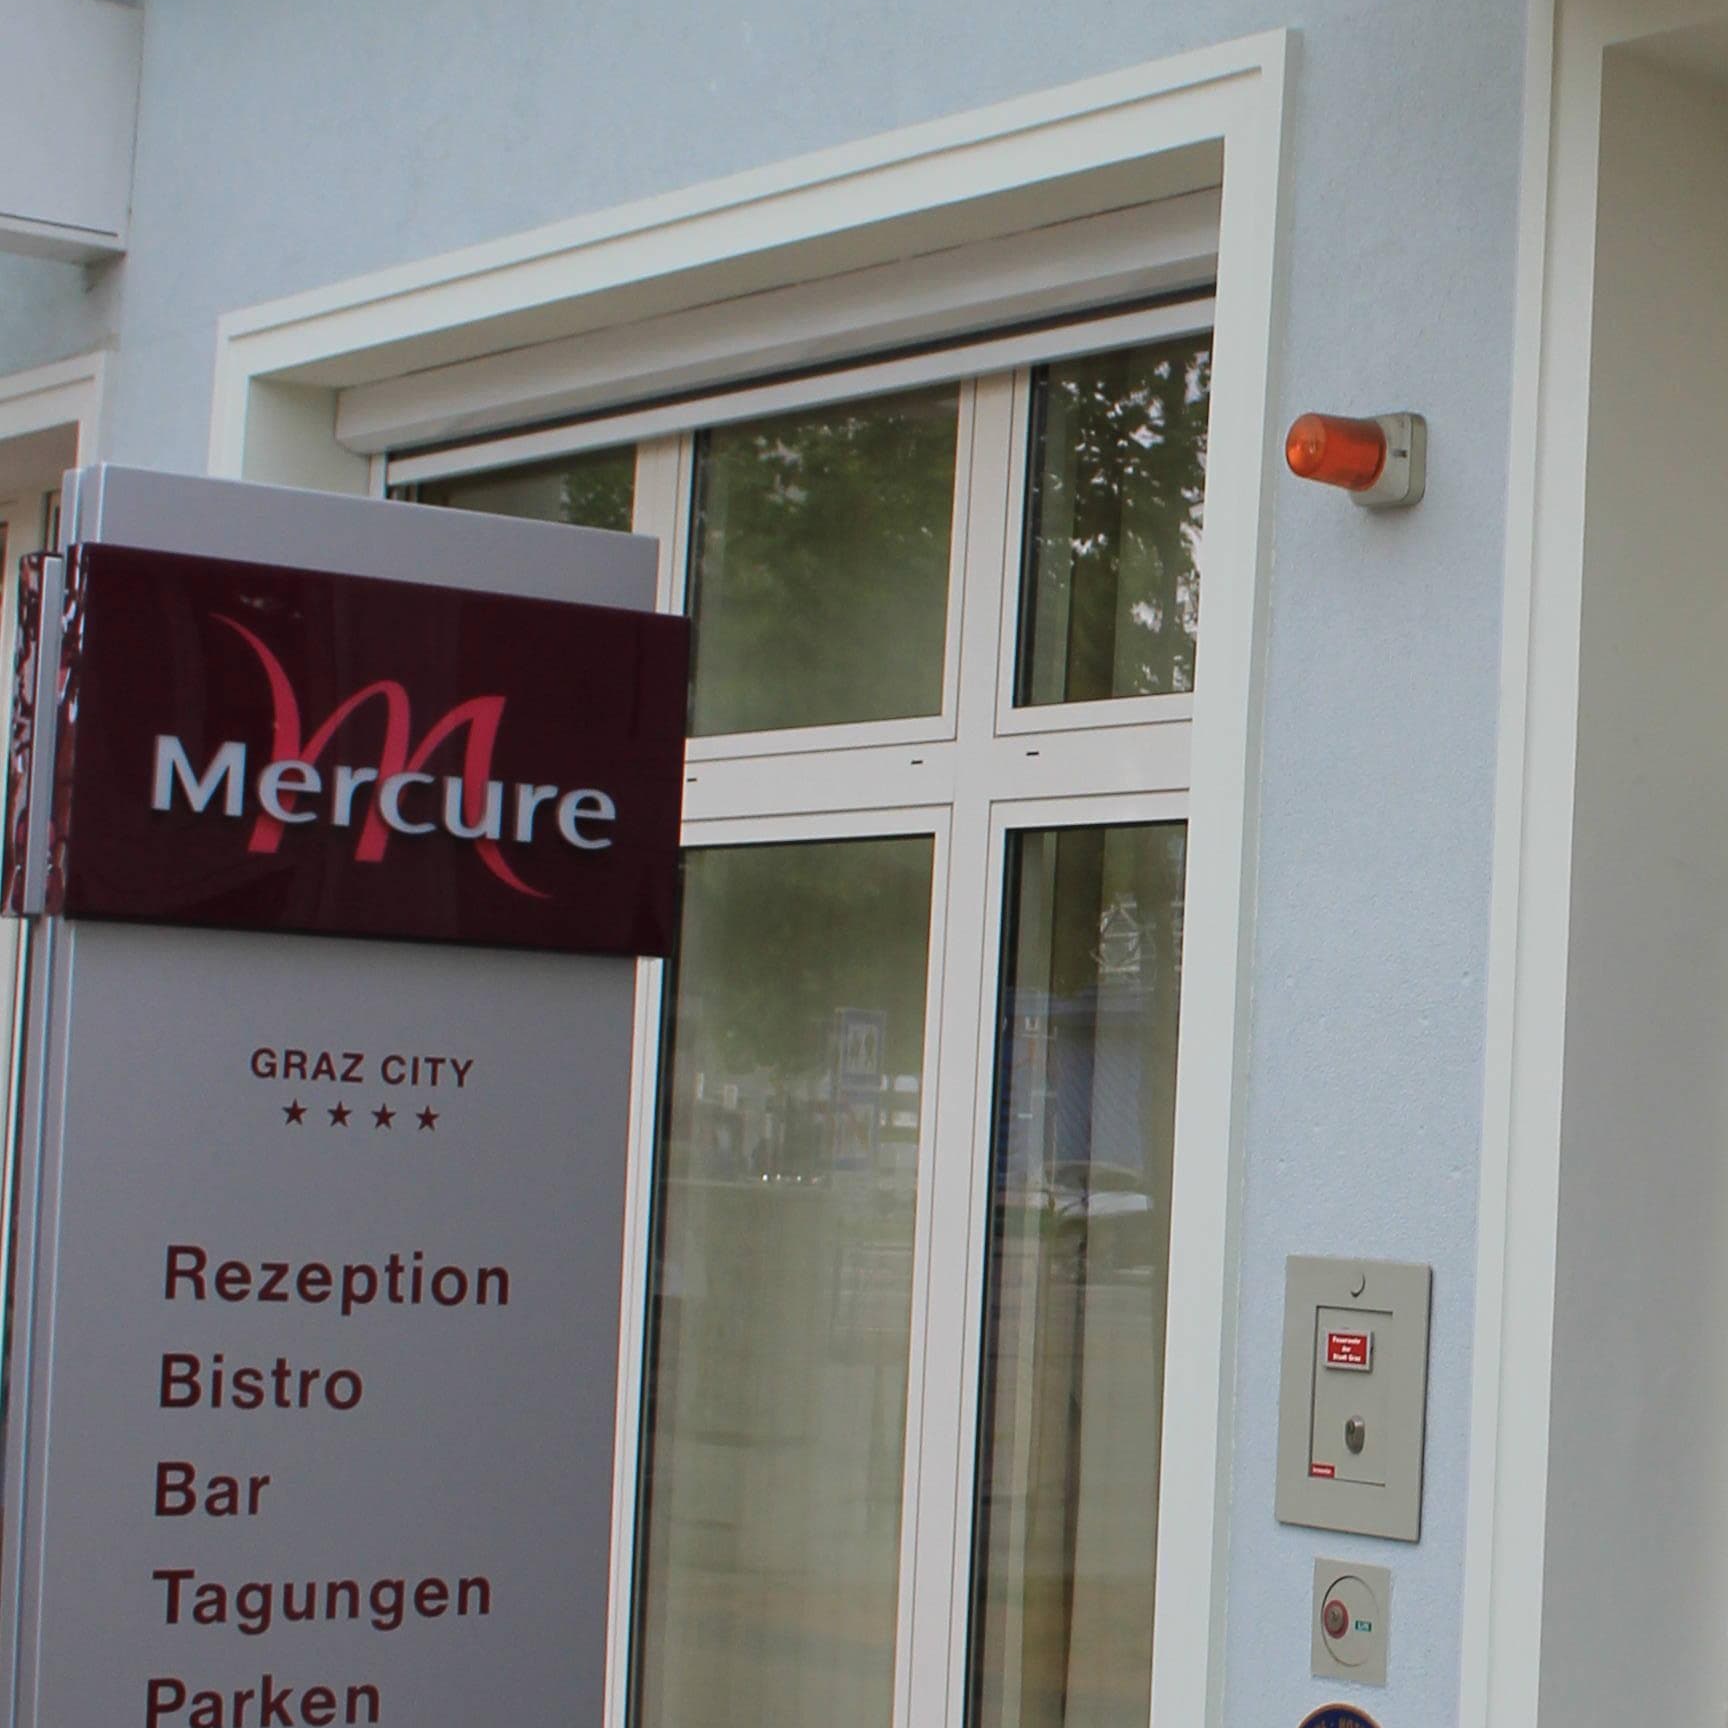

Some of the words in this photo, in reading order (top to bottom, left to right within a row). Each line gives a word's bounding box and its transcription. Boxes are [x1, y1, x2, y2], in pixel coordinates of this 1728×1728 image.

[150, 733, 617, 851] Mercure
[249, 1047, 365, 1085] GRAZ
[380, 1054, 474, 1089] CITY
[163, 1244, 510, 1316] Rezeption
[158, 1352, 364, 1411] Bistro
[154, 1461, 271, 1518] Bar
[151, 1569, 491, 1636] Tagungen
